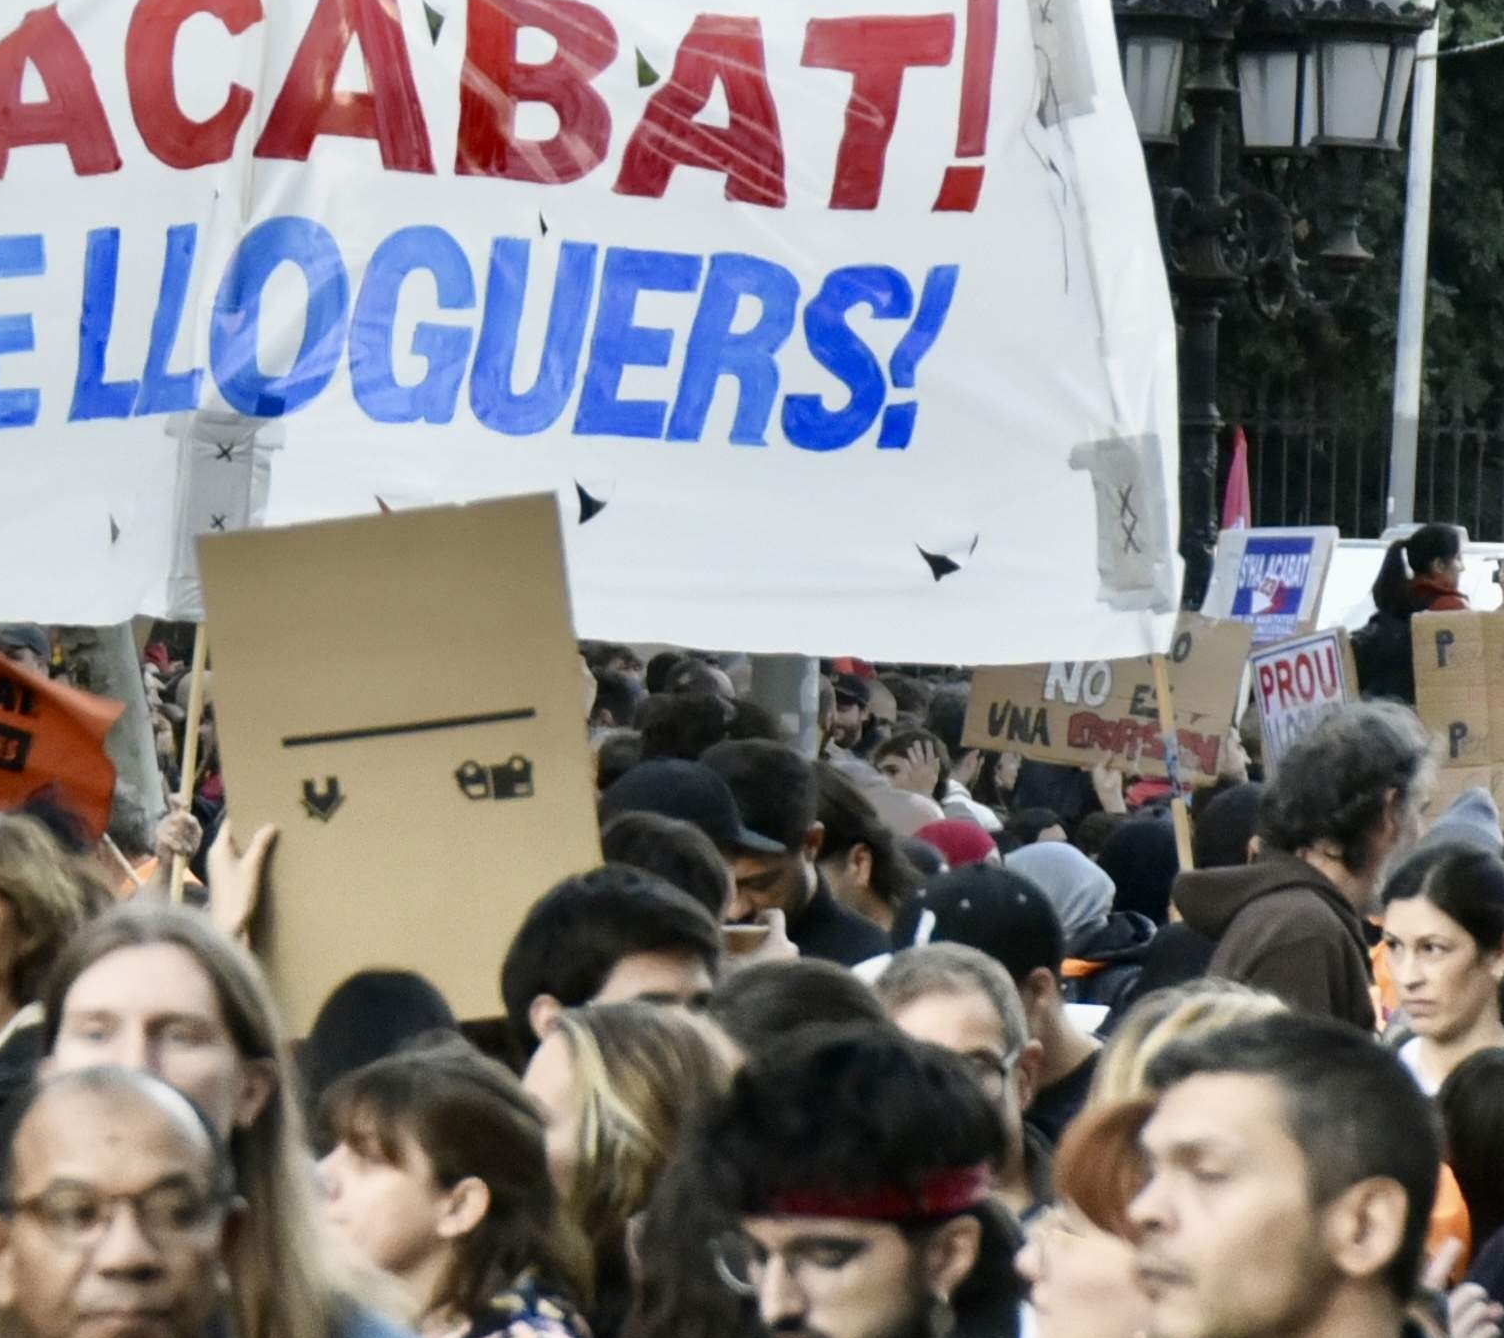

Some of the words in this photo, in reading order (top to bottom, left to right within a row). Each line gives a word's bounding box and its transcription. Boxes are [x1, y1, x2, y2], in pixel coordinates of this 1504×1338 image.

[68, 214, 961, 453] LLOGUERS!
[1044, 661, 1113, 707] NO
[1258, 645, 1338, 715] PROU
[987, 700, 1051, 747] UNA
